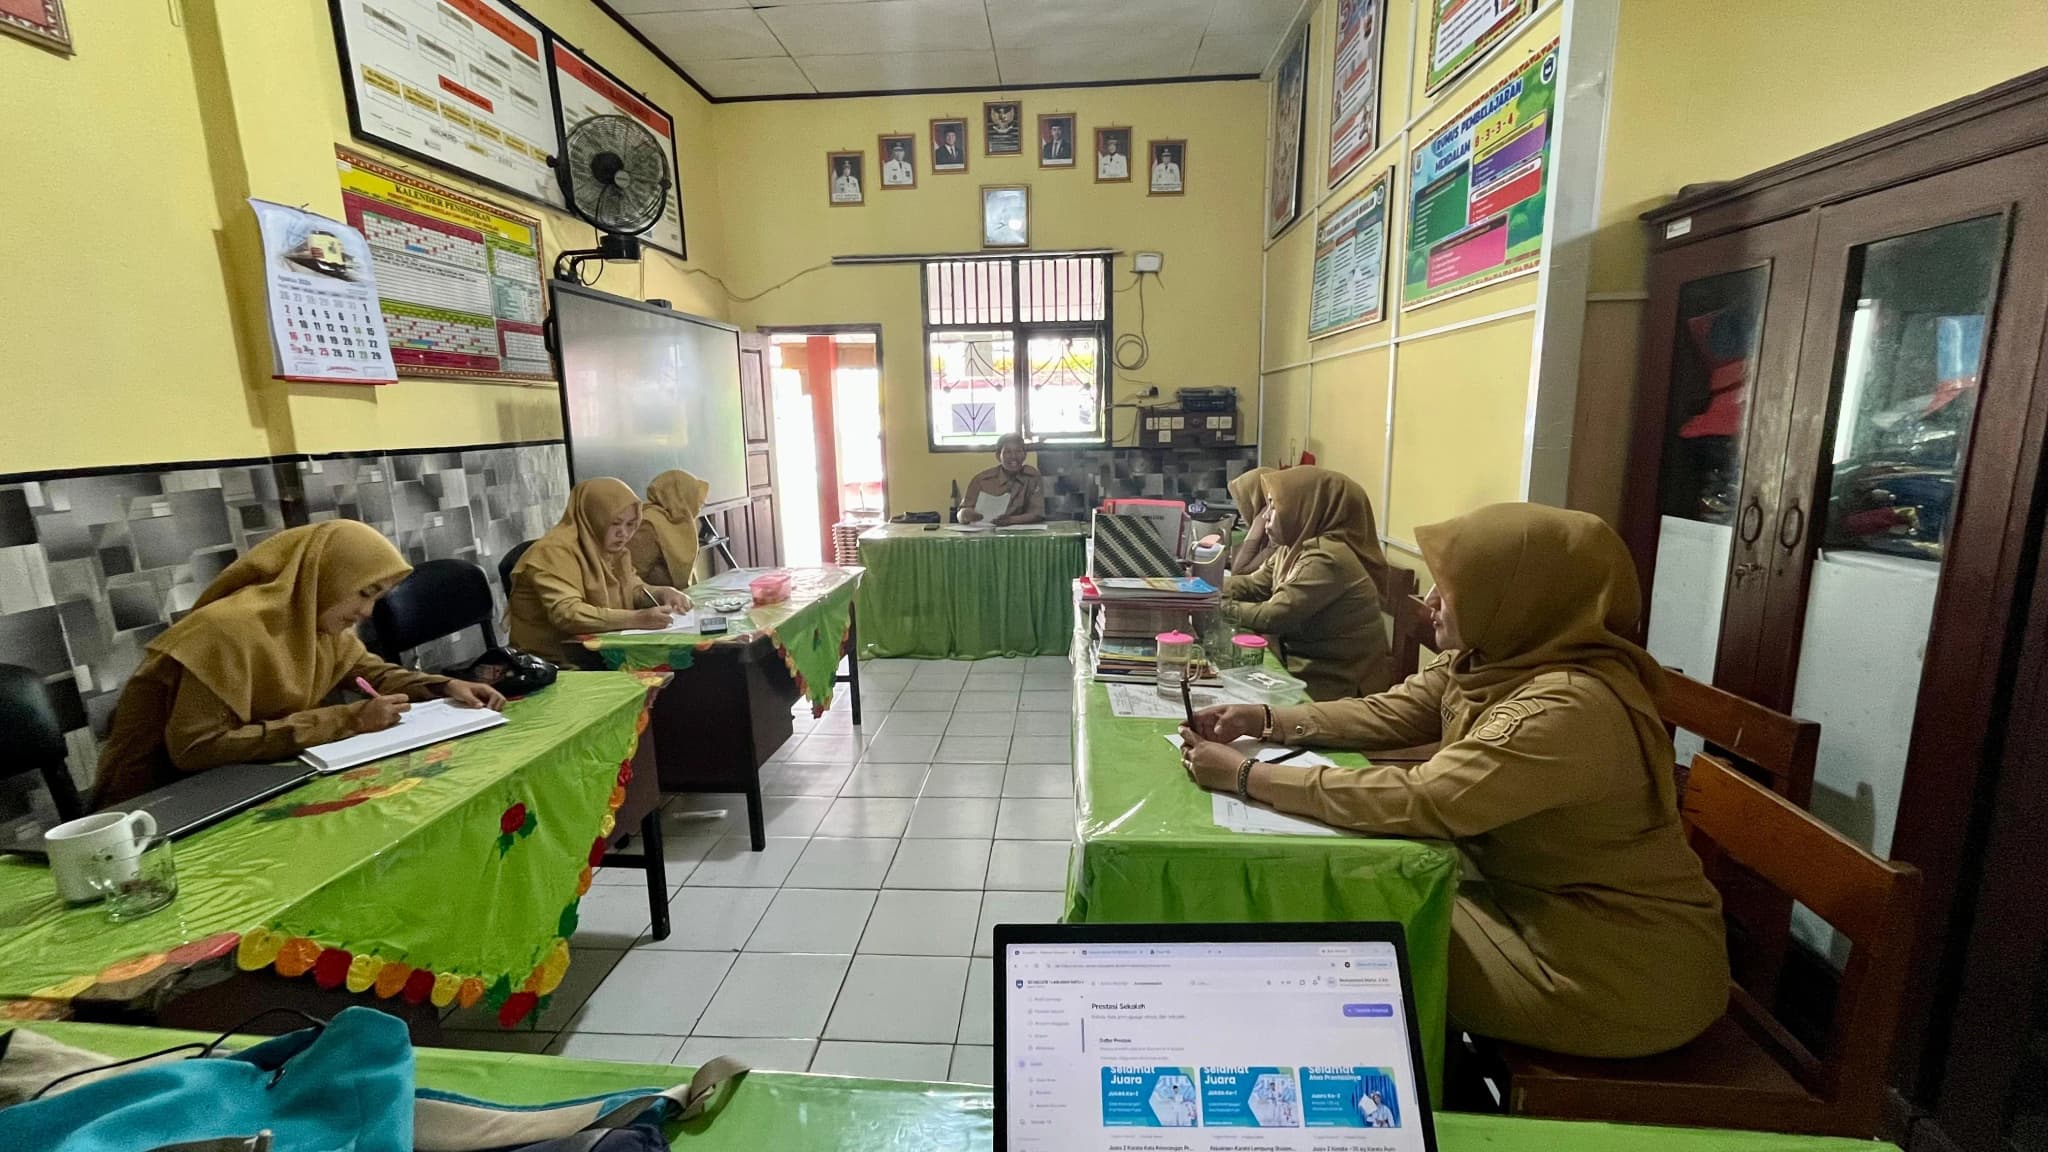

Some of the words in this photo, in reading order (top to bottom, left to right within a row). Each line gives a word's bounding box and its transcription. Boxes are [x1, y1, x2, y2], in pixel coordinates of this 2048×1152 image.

[1461, 79, 1522, 135] PEMBELAJARAN
[1435, 140, 1471, 173] MENDALAM
[394, 183, 443, 207] KALENDER
[445, 198, 492, 222] PENDIDIKAN
[284, 304, 290, 314] 2
[297, 306, 303, 316] 3
[311, 309, 317, 318] 4
[324, 310, 330, 319] 5
[338, 312, 344, 321] 6
[365, 315, 371, 324] 8
[363, 303, 368, 312] 1
[287, 318, 293, 327] 9
[299, 320, 308, 329] 10
[313, 322, 321, 331] 11
[326, 323, 335, 332] 12
[340, 325, 349, 333] 13
[366, 327, 375, 336] 15
[289, 331, 298, 341] 16
[304, 333, 312, 342] 17
[316, 334, 325, 344] 18
[329, 336, 339, 345] 19
[343, 337, 353, 346] 20
[368, 339, 378, 348] 22
[319, 347, 330, 356] 25
[332, 348, 343, 358] 26
[346, 350, 355, 359] 27
[358, 350, 368, 359] 28
[371, 352, 381, 360] 29
[1110, 1065, 1156, 1074] Selamat
[1204, 1065, 1250, 1074] Selamat
[1309, 1065, 1355, 1074] Selamat
[1110, 1075, 1143, 1085] Juara
[1204, 1075, 1237, 1085] Juara
